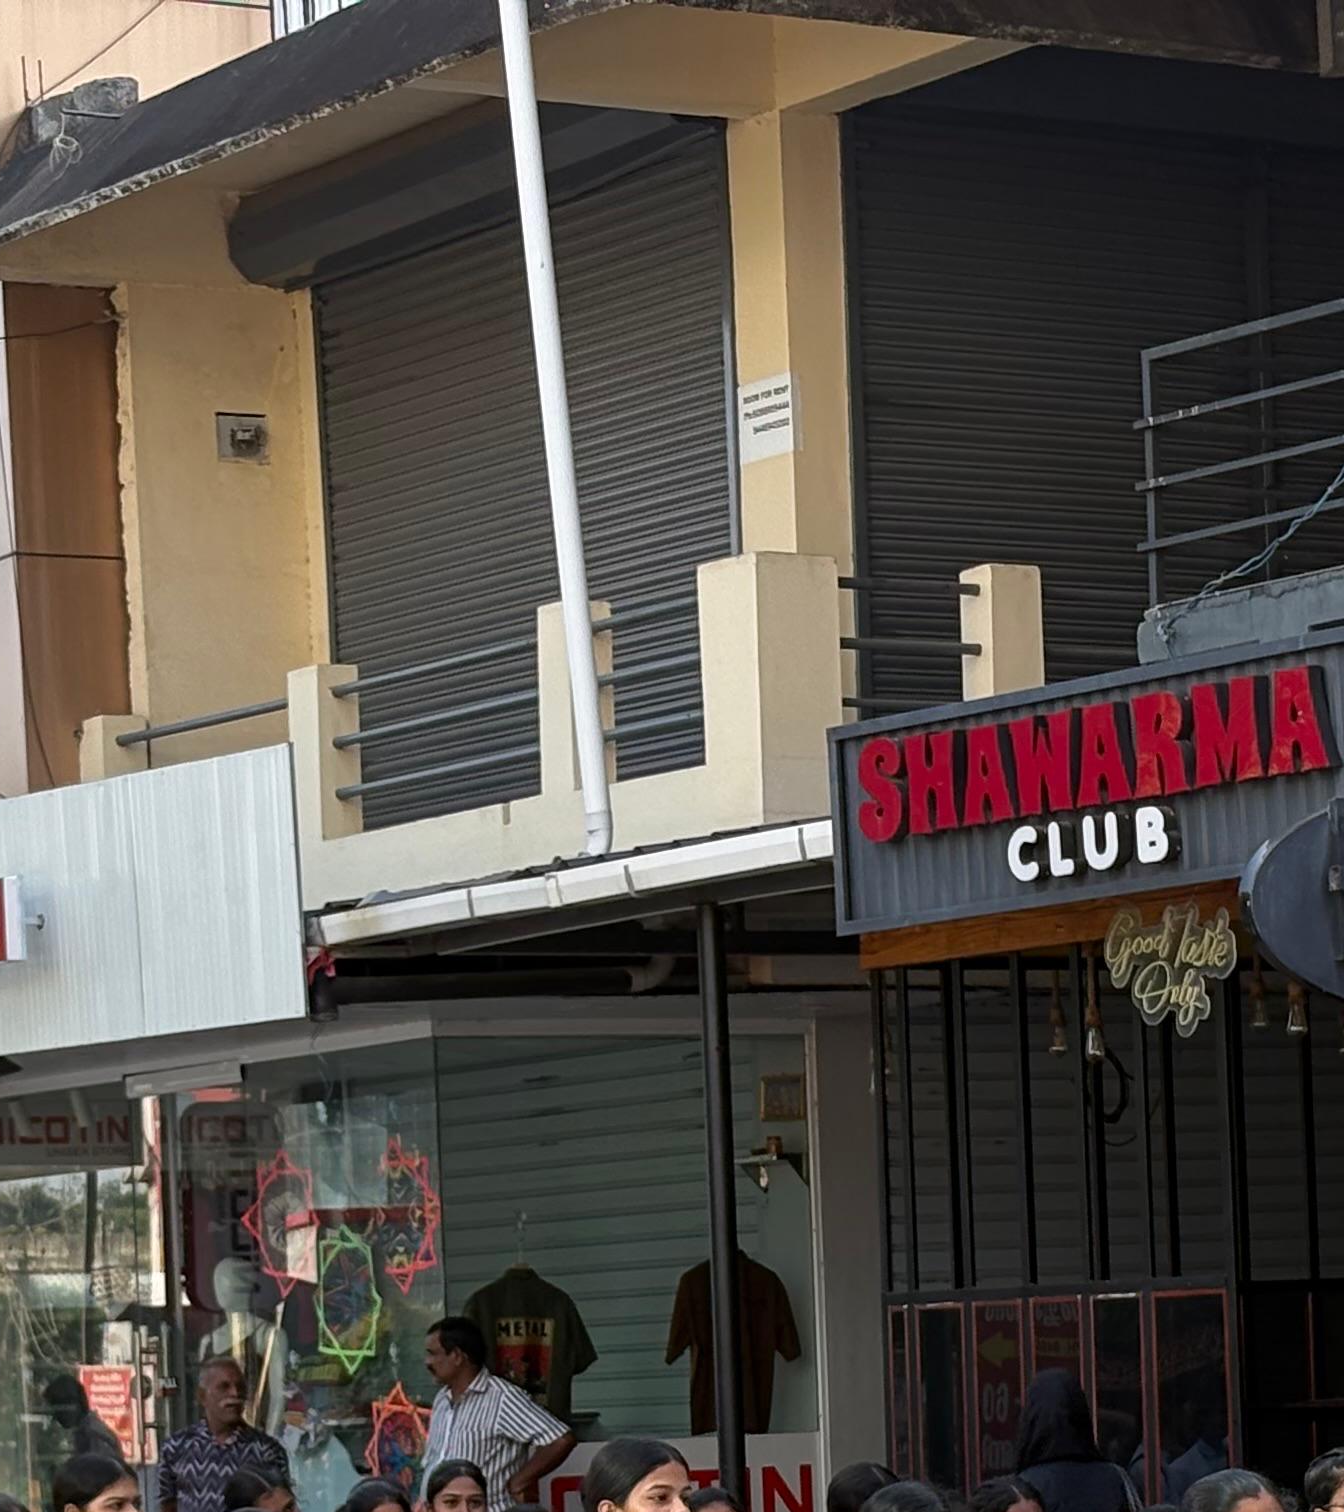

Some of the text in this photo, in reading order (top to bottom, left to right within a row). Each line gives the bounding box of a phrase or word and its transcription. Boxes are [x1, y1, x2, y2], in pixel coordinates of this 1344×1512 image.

[858, 665, 1333, 844] SHAWARMA
[1008, 806, 1171, 884] CLUB
[1107, 906, 1171, 978] Good
[1134, 961, 1205, 1026] Only
